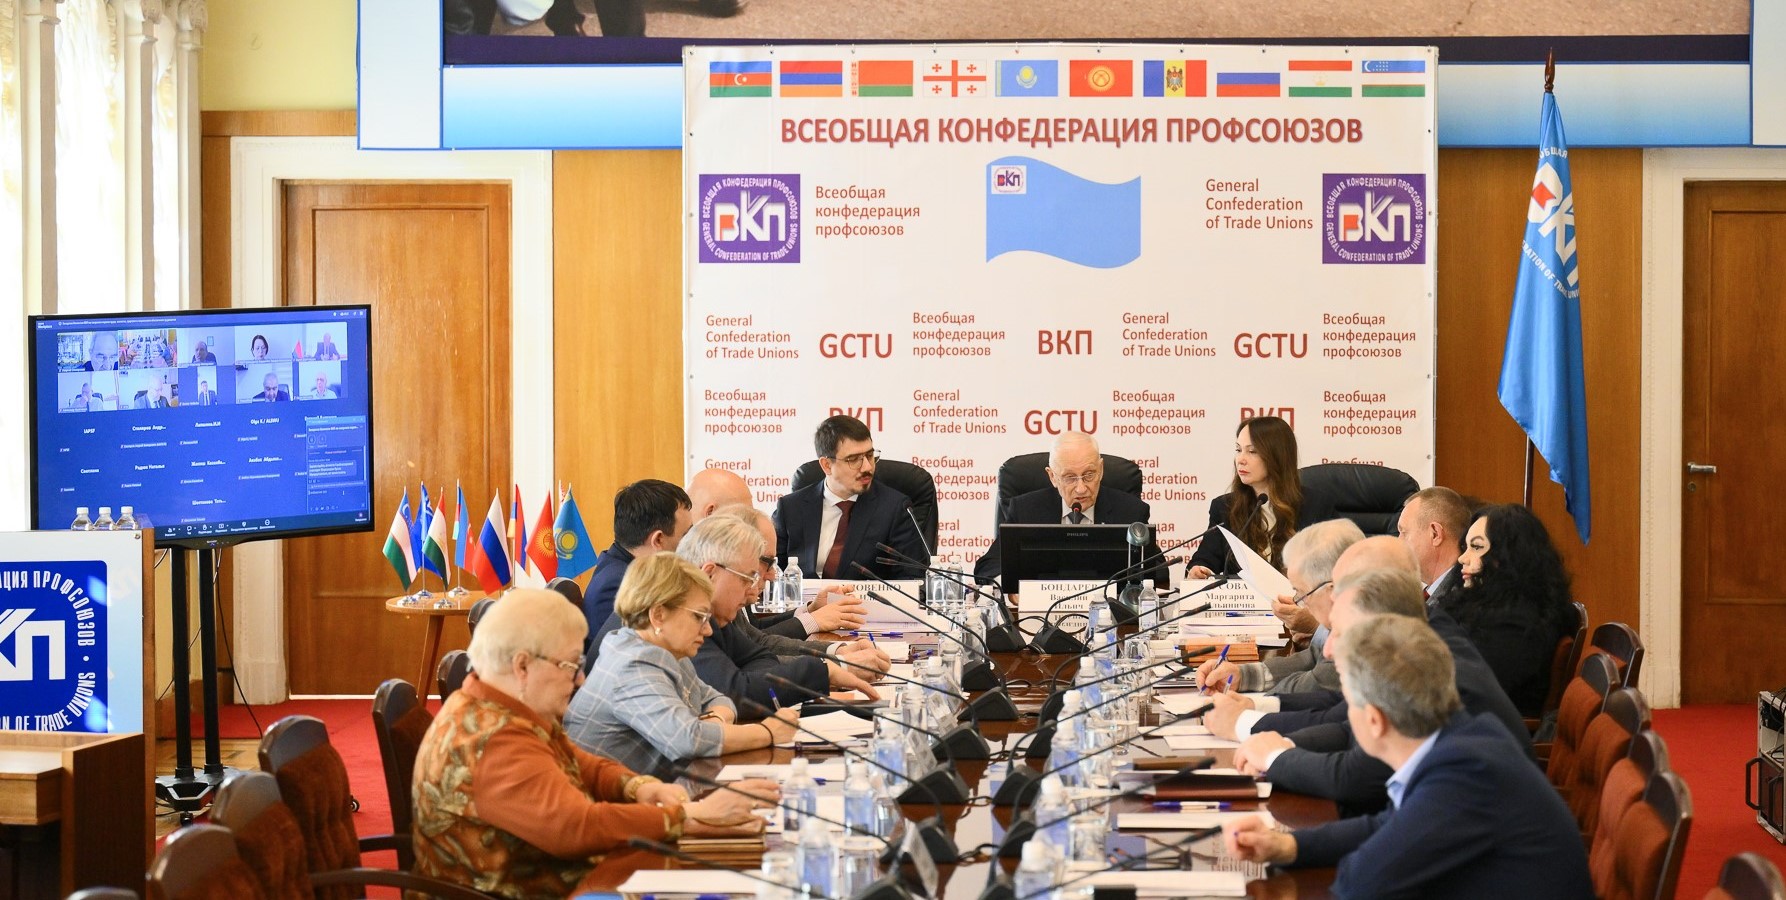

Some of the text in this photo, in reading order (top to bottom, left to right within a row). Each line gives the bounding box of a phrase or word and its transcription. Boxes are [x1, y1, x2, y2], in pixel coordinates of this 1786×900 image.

[782, 118, 1362, 147] ВСЕОБЩАЯ КОНФЕДЕРАЦИЯ ПРОФСОЮЗОВ
[816, 185, 886, 200] Всеобщая
[1205, 177, 1260, 193] General
[703, 178, 797, 220] ВСЕОБЩАЯ КОНФЕДЕРАЦИЯ ПРОФСОЮЗОВ
[1206, 196, 1303, 211] Confederation
[1327, 178, 1423, 220] ВСЕОБЩАЯ КОНФЕДЕРАЦИЯ ПРОФСОЮЗОВ
[715, 190, 785, 241] ВКП
[816, 205, 921, 221] конфедерация
[1339, 191, 1410, 241] ВКП
[816, 220, 904, 239] профсоюзов
[1205, 215, 1313, 230] of Trade Unions
[703, 222, 797, 261] GENERAL CONFEDERATION OF TRADE UNIONS
[1327, 223, 1423, 261] GENERAL CONFEDERATION OF TRADE UNIONS
[705, 314, 752, 327] General
[912, 312, 975, 325] Всеобщая
[1122, 312, 1169, 324] General
[1322, 313, 1386, 328] Всеобщая
[706, 331, 791, 343] Confederation
[912, 329, 1006, 344] конфедерация
[1122, 328, 1208, 341] Confederation
[1323, 330, 1416, 344] конфедерация
[819, 333, 892, 359] GCTU
[1038, 330, 1092, 355] ВКП
[1234, 332, 1308, 359] GCTU
[707, 347, 799, 359] of Trade Unions
[913, 343, 992, 358] профсоюзов
[1123, 345, 1216, 356] of Trade Unions
[1324, 344, 1402, 358] профсоюзов
[705, 388, 767, 403] Всеобщая
[913, 389, 960, 401] General
[1112, 390, 1176, 403] Всеобщая
[1323, 390, 1387, 405] Всеобщая
[705, 406, 796, 419] конфедерация
[913, 406, 998, 417] Confederation
[1112, 407, 1205, 421] конфедерация
[1323, 406, 1416, 423] конфедерация
[704, 422, 783, 435] профсоюзов
[914, 422, 1006, 433] of Trade Unions
[1024, 410, 1098, 435] GCTU
[1112, 423, 1191, 436] профсоюзов
[1324, 422, 1403, 436] профсоюзов
[912, 456, 973, 470] Всеобщая
[935, 473, 996, 486] федераци
[1142, 473, 1197, 484] ederation
[937, 490, 989, 502] фсоюзов
[1165, 489, 1205, 500] Unions
[1206, 593, 1254, 603] Маргарита
[33, 570, 95, 646] ПРОФСОЮЗОВ
[67, 672, 95, 717] UNIONS
